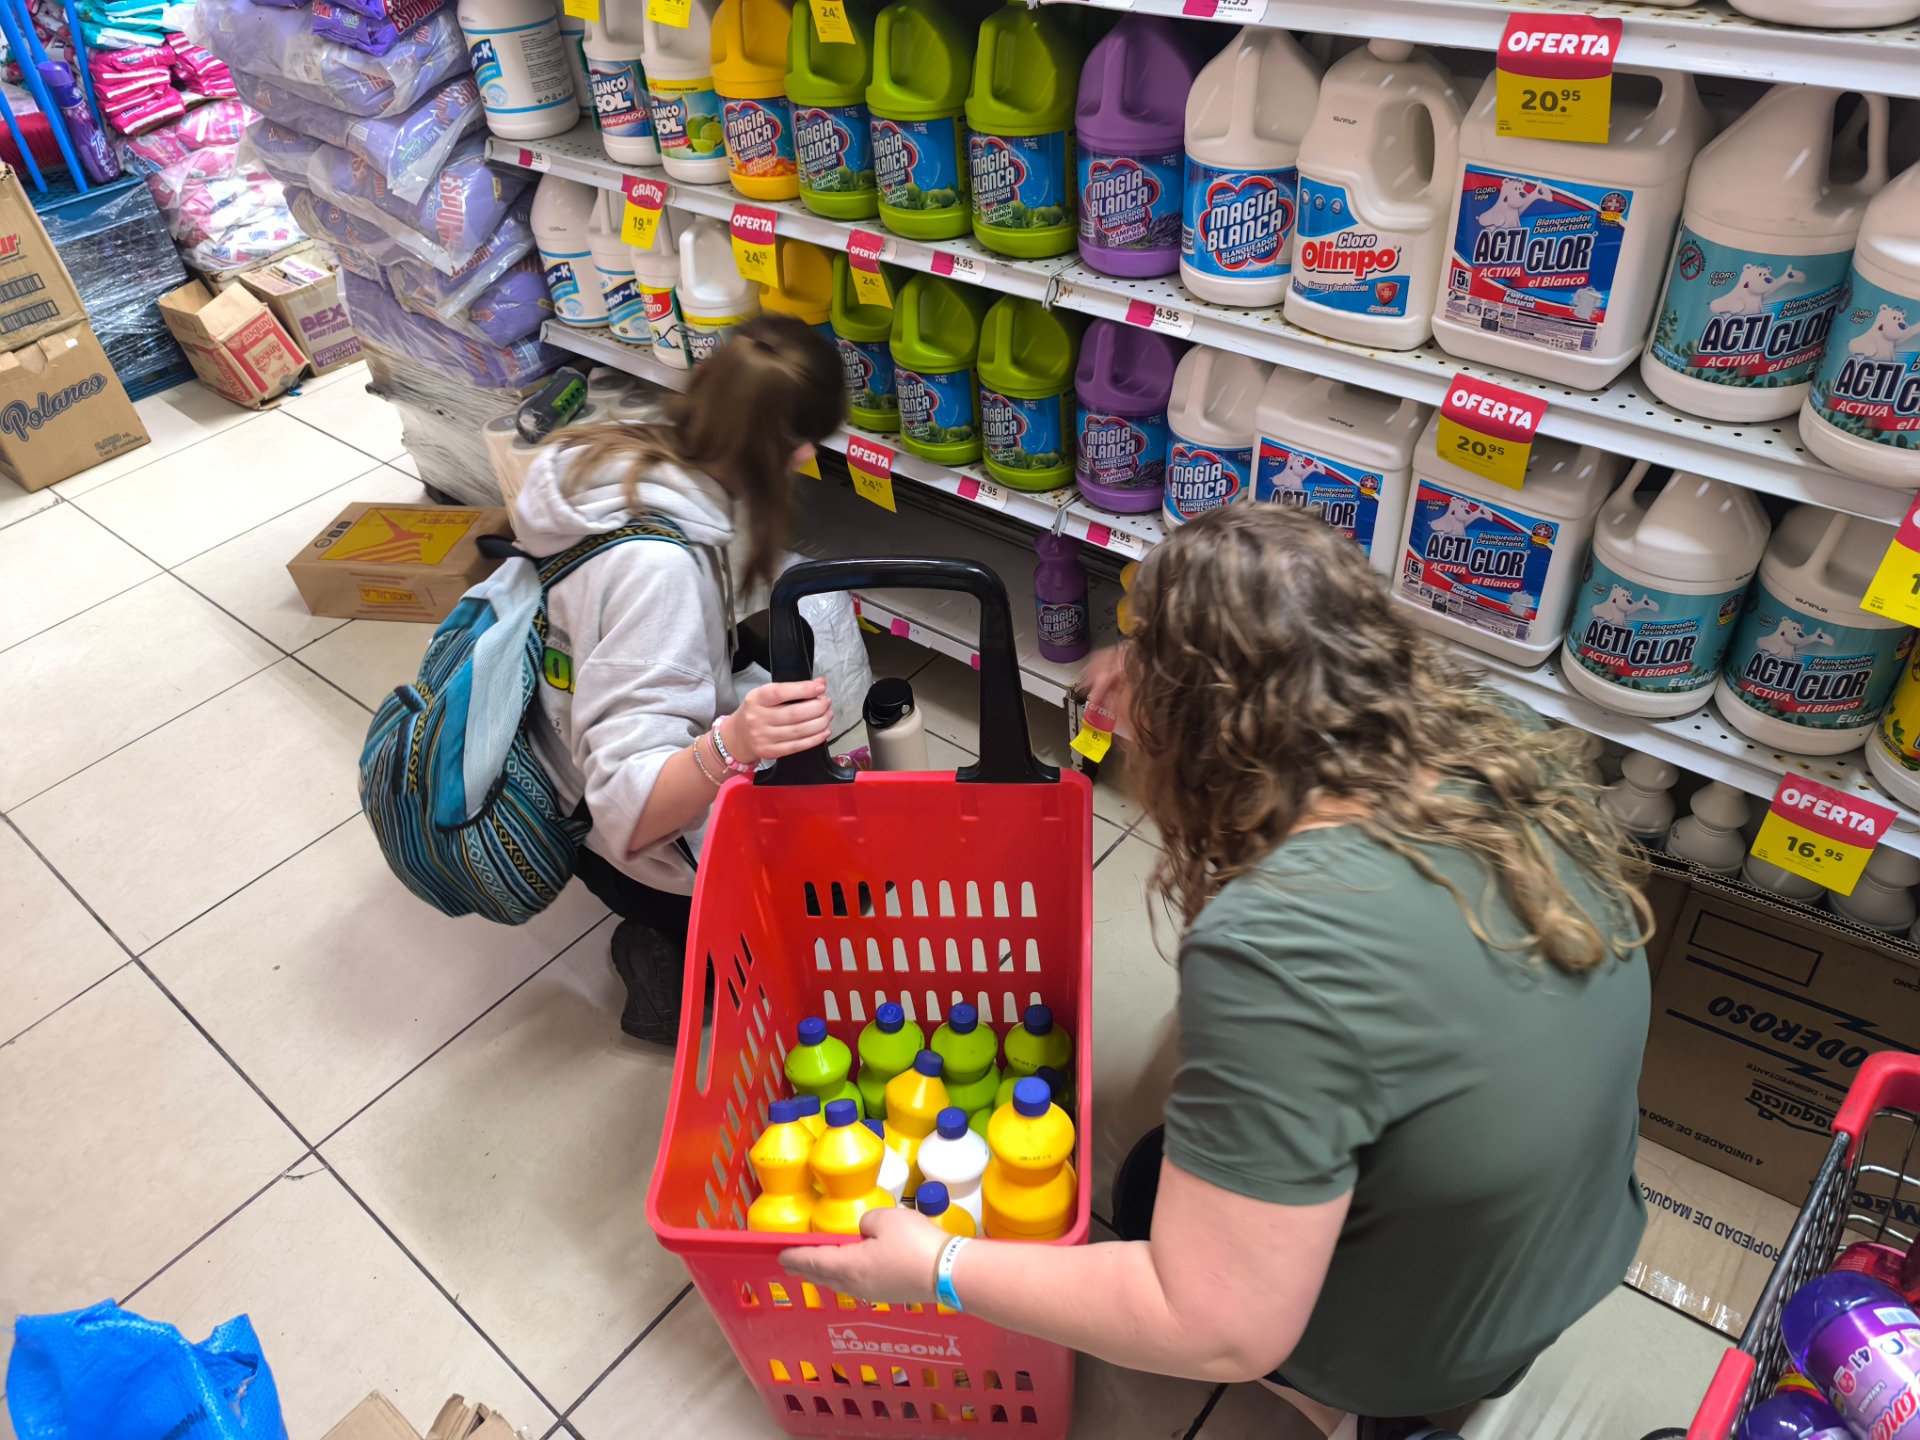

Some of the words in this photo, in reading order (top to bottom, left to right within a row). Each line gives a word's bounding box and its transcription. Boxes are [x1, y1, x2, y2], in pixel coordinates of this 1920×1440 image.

[1508, 31, 1609, 56] OFERTA
[597, 91, 632, 113] SOL
[1521, 89, 1581, 112] 20.95
[728, 111, 765, 137] MAGIA
[798, 120, 833, 147] MAGIA
[731, 124, 772, 153] BLANCA
[874, 134, 901, 157] MAGIA
[799, 135, 840, 164] BLANCA
[875, 150, 908, 175] BLANCA
[973, 150, 1009, 176] MAGIA
[814, 169, 838, 183] CAMPOS
[973, 167, 1015, 193] BLANCA
[1093, 169, 1143, 200] MAGIA
[631, 184, 663, 203] GRATIS
[1091, 186, 1148, 218] BLANCA
[986, 204, 1010, 215] CAMPOS
[1101, 207, 1146, 224] BLANQUEADOR
[1210, 188, 1278, 230] MAGIA
[732, 215, 773, 233] OFERTA
[1101, 213, 1146, 229] DESINFECTANTE
[1533, 222, 1592, 235] Desinfectante
[1536, 214, 1592, 227] Blanqueador
[1110, 223, 1141, 239] CAMPOS
[1119, 229, 1146, 243] LAVANDA
[1206, 208, 1283, 253] BLANCA
[1222, 234, 1278, 258] BLANQUEADOR
[1337, 232, 1377, 249] Cloro
[1473, 227, 1530, 264] ACTI
[1526, 233, 1594, 273] CLOR
[850, 245, 877, 260] OFERTA
[1221, 241, 1278, 265] DESINFECTANTE
[1301, 241, 1399, 278] Olimpo
[1479, 267, 1521, 278] ACTIVA
[1528, 277, 1540, 288] el
[1542, 276, 1586, 287] Blanco
[1503, 296, 1535, 309] Natural
[1505, 289, 1534, 300] Fuerza
[299, 303, 348, 333] BEX
[1699, 313, 1775, 354] ACTI
[1766, 305, 1838, 359] CLOR
[314, 337, 361, 361] SUAVIZANTE
[1705, 354, 1760, 367] ACTIVA
[1768, 359, 1781, 373] el
[1783, 349, 1824, 369] Blanc
[1834, 357, 1907, 402] ACTI
[898, 382, 925, 399] MAGIA
[0, 373, 107, 442] Polanco
[983, 407, 1013, 421] MAGIA
[1451, 389, 1532, 430] OFERTA
[1836, 401, 1889, 417] ACTIVA
[1896, 418, 1910, 430] el
[1087, 427, 1130, 445] MAGIA
[849, 444, 889, 469] OFERTA
[1087, 440, 1136, 458] BLANCA
[1456, 435, 1505, 460] 20.95
[1102, 468, 1129, 478] CAMPOS
[1172, 463, 1223, 488] MAGIA
[1171, 478, 1228, 502] BLANCA
[1475, 538, 1526, 548] Desinfectante
[1478, 532, 1524, 542] Blanqueador
[1425, 532, 1473, 563] ACTI
[1469, 549, 1526, 579] CLOR
[1431, 562, 1466, 574] ACTIVA
[1472, 577, 1482, 586] el
[1484, 578, 1520, 589] Blanco
[1043, 615, 1079, 632] BLANCA
[1044, 607, 1075, 623] MAGIA
[1638, 626, 1698, 635] Desinfectante
[1641, 621, 1697, 630] Blanqueador
[1584, 618, 1635, 655] ACTI
[1628, 634, 1699, 665] CLOR
[1586, 651, 1625, 666] ACTIVA
[1808, 660, 1874, 671] Desinfectante
[1812, 654, 1874, 665] Blanqueador
[1631, 669, 1642, 677] el
[1645, 665, 1688, 677] Blanco
[1668, 669, 1717, 687] Eucalip
[1743, 651, 1804, 690] ACTI
[1795, 669, 1873, 701] CLOR
[1746, 683, 1791, 702] ACTIVA
[1089, 703, 1115, 720] OFERTA
[1796, 704, 1811, 714] el
[1813, 701, 1859, 712] Blanco
[1782, 788, 1875, 836] OFERTA
[1786, 836, 1844, 863] 16.95
[1707, 996, 1866, 1068] ODEROSO
[1746, 1063, 1818, 1096] DESINFECTANTE
[1649, 1111, 1674, 1128] 5000
[1676, 1123, 1692, 1137] DE
[1694, 1131, 1754, 1164] UNIDADES
[1756, 1158, 1764, 1166] 4
[1693, 1210, 1713, 1230] DE
[1714, 1221, 1781, 1261] ROPIEDAD
[828, 1327, 858, 1339] LA
[831, 1337, 961, 1356] BODEGONA
